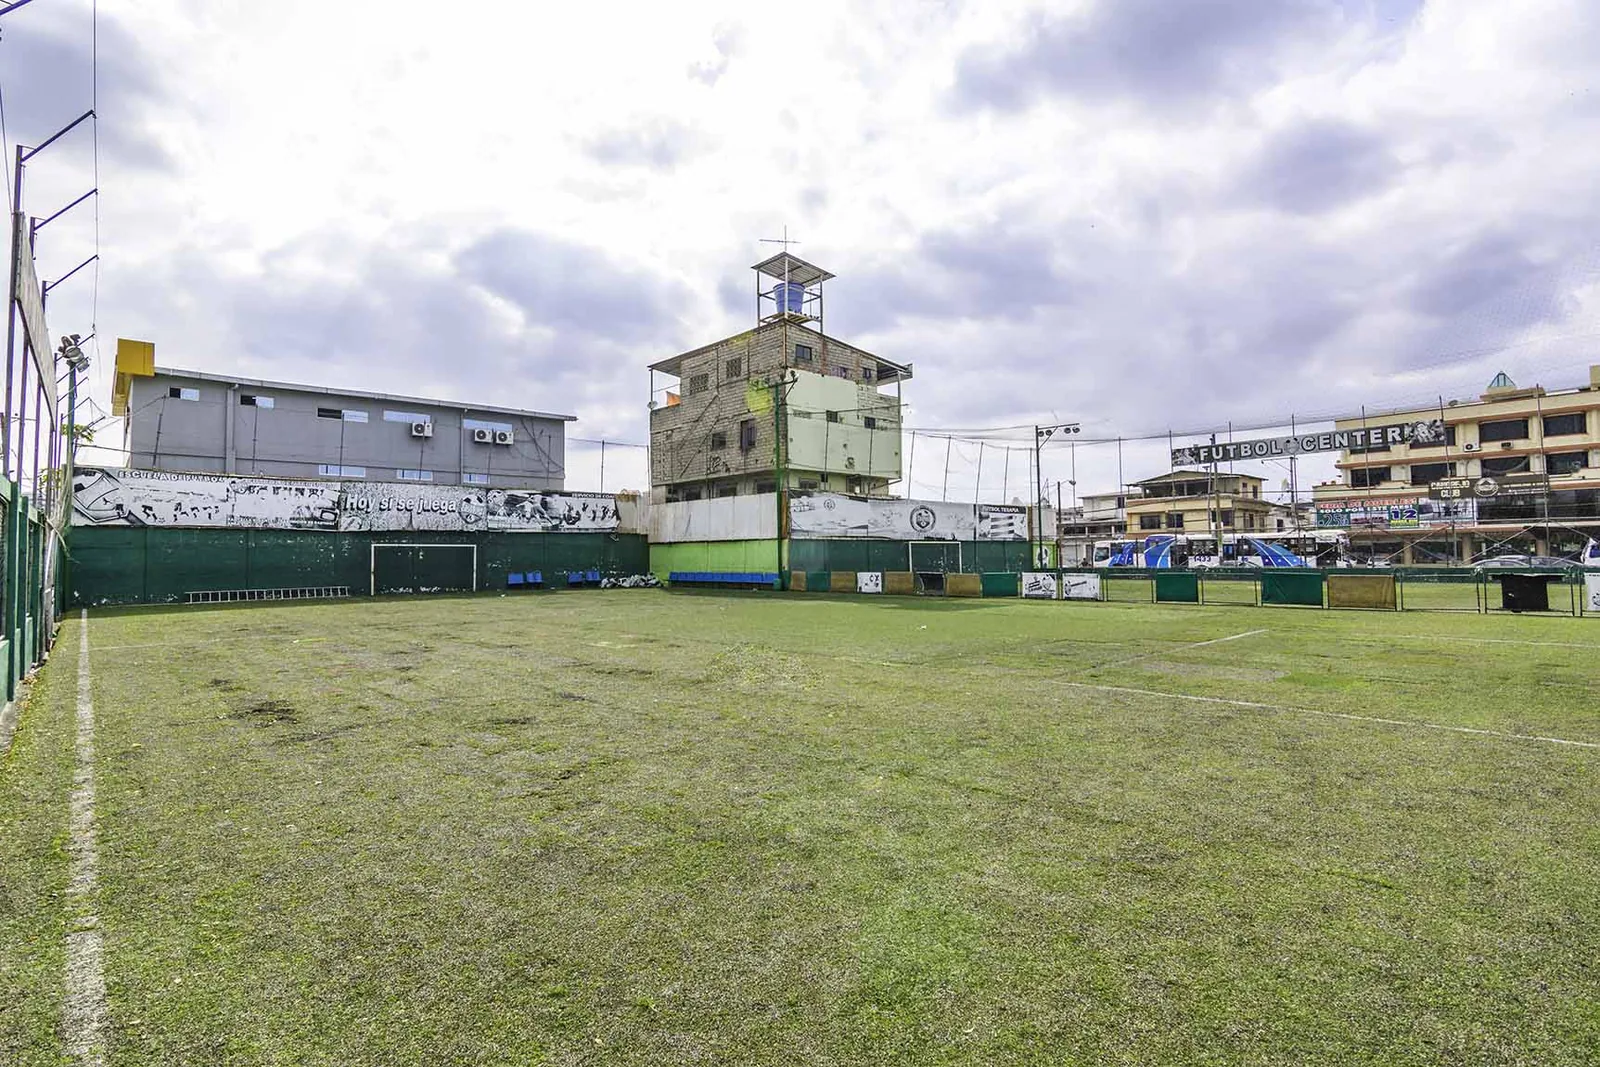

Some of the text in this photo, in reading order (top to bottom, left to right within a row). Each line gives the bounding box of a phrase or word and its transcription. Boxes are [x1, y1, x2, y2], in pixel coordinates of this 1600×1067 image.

[1199, 427, 1402, 461] FUTBOL CENTER
[118, 470, 168, 481] ESCUELA
[343, 493, 376, 514] Hoy
[396, 497, 414, 512] se
[417, 496, 457, 515] juega
